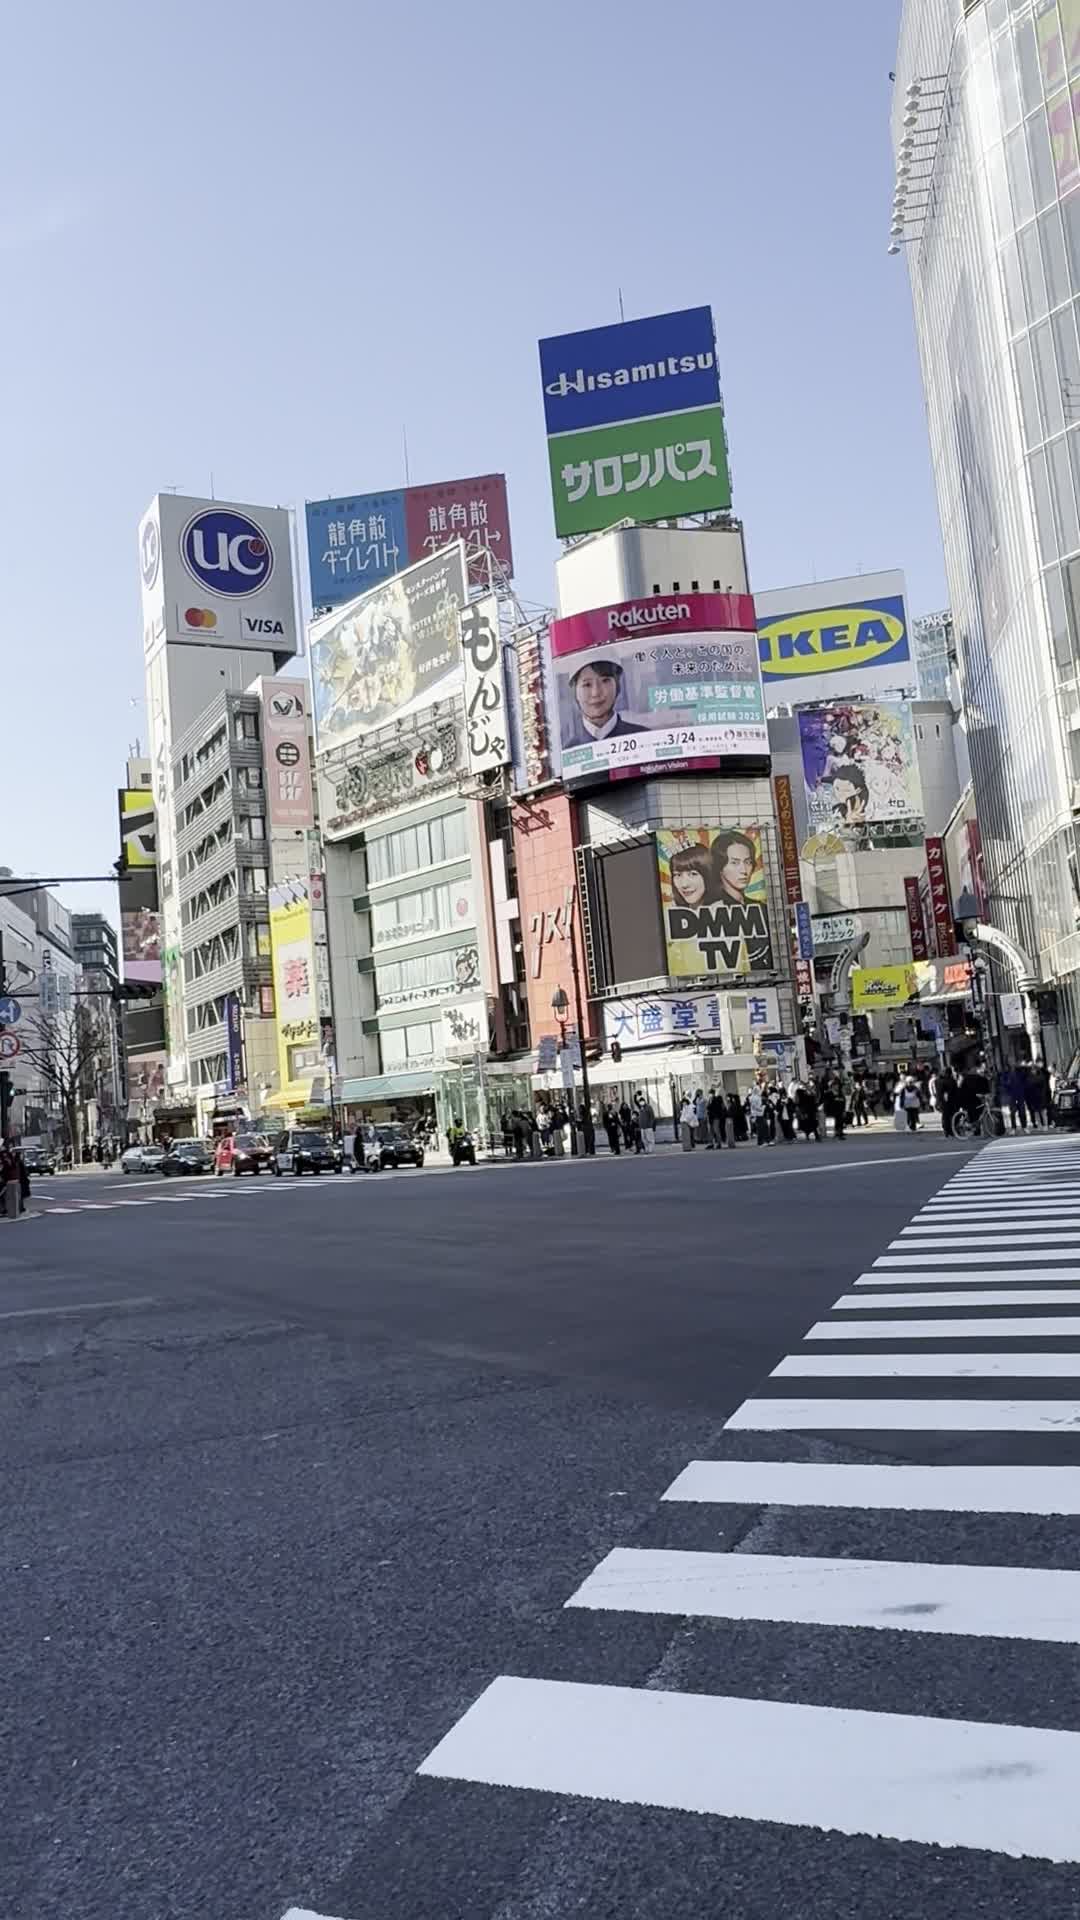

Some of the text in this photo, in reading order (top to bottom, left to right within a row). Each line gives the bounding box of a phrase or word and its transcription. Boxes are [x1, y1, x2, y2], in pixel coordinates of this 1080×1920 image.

[546, 352, 714, 396] Hisamitsu
[561, 439, 717, 502] サロンパス
[328, 514, 387, 547] 龍角散
[428, 500, 488, 533] 龍角散
[193, 529, 265, 576] UC
[423, 527, 501, 554] ダイクト
[321, 543, 399, 575] ダイレクト
[245, 618, 284, 634] VISA
[608, 603, 691, 629] Rakuten
[758, 619, 893, 662] IKEA
[461, 605, 505, 760] もんじゃ
[654, 685, 756, 703] 労働基準監督官
[611, 739, 637, 753] 2/20
[667, 732, 695, 744] 3/24
[928, 847, 947, 913] カラオケ
[668, 904, 768, 940] DMM
[815, 929, 855, 942] クリニック
[699, 940, 743, 970] TV
